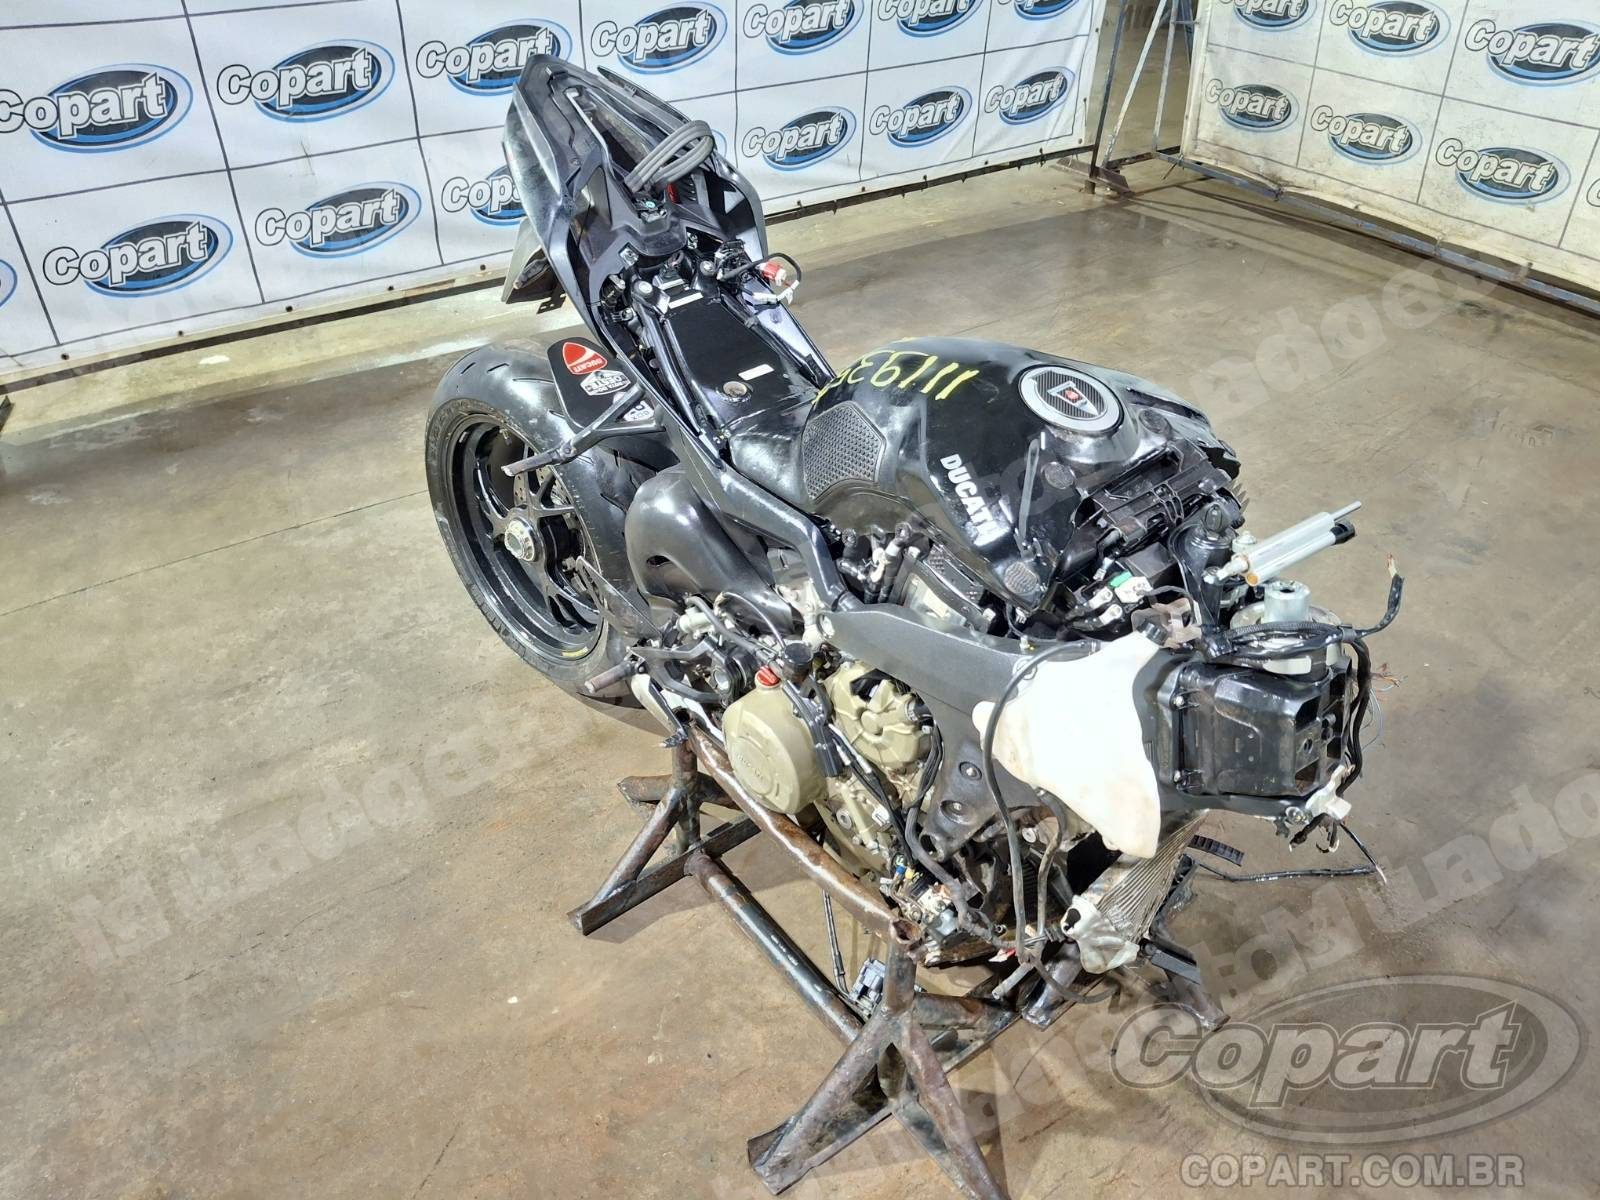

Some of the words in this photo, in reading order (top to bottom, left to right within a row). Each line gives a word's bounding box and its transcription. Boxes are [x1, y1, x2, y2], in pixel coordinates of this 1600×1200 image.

[590, 5, 709, 67] Copart
[743, 0, 849, 43] Copart
[1329, 0, 1437, 42] Copart
[1465, 19, 1600, 69] Copart
[218, 48, 373, 108] Copart
[984, 72, 1064, 113] Copart
[1205, 78, 1289, 121] Copart
[741, 112, 844, 158] Copart
[868, 88, 960, 136] Copart
[1311, 105, 1413, 153] Copart
[1436, 137, 1556, 192] Copart
[255, 189, 399, 247] Copart
[43, 220, 207, 288] Copart
[940, 454, 1006, 546] DUCATI
